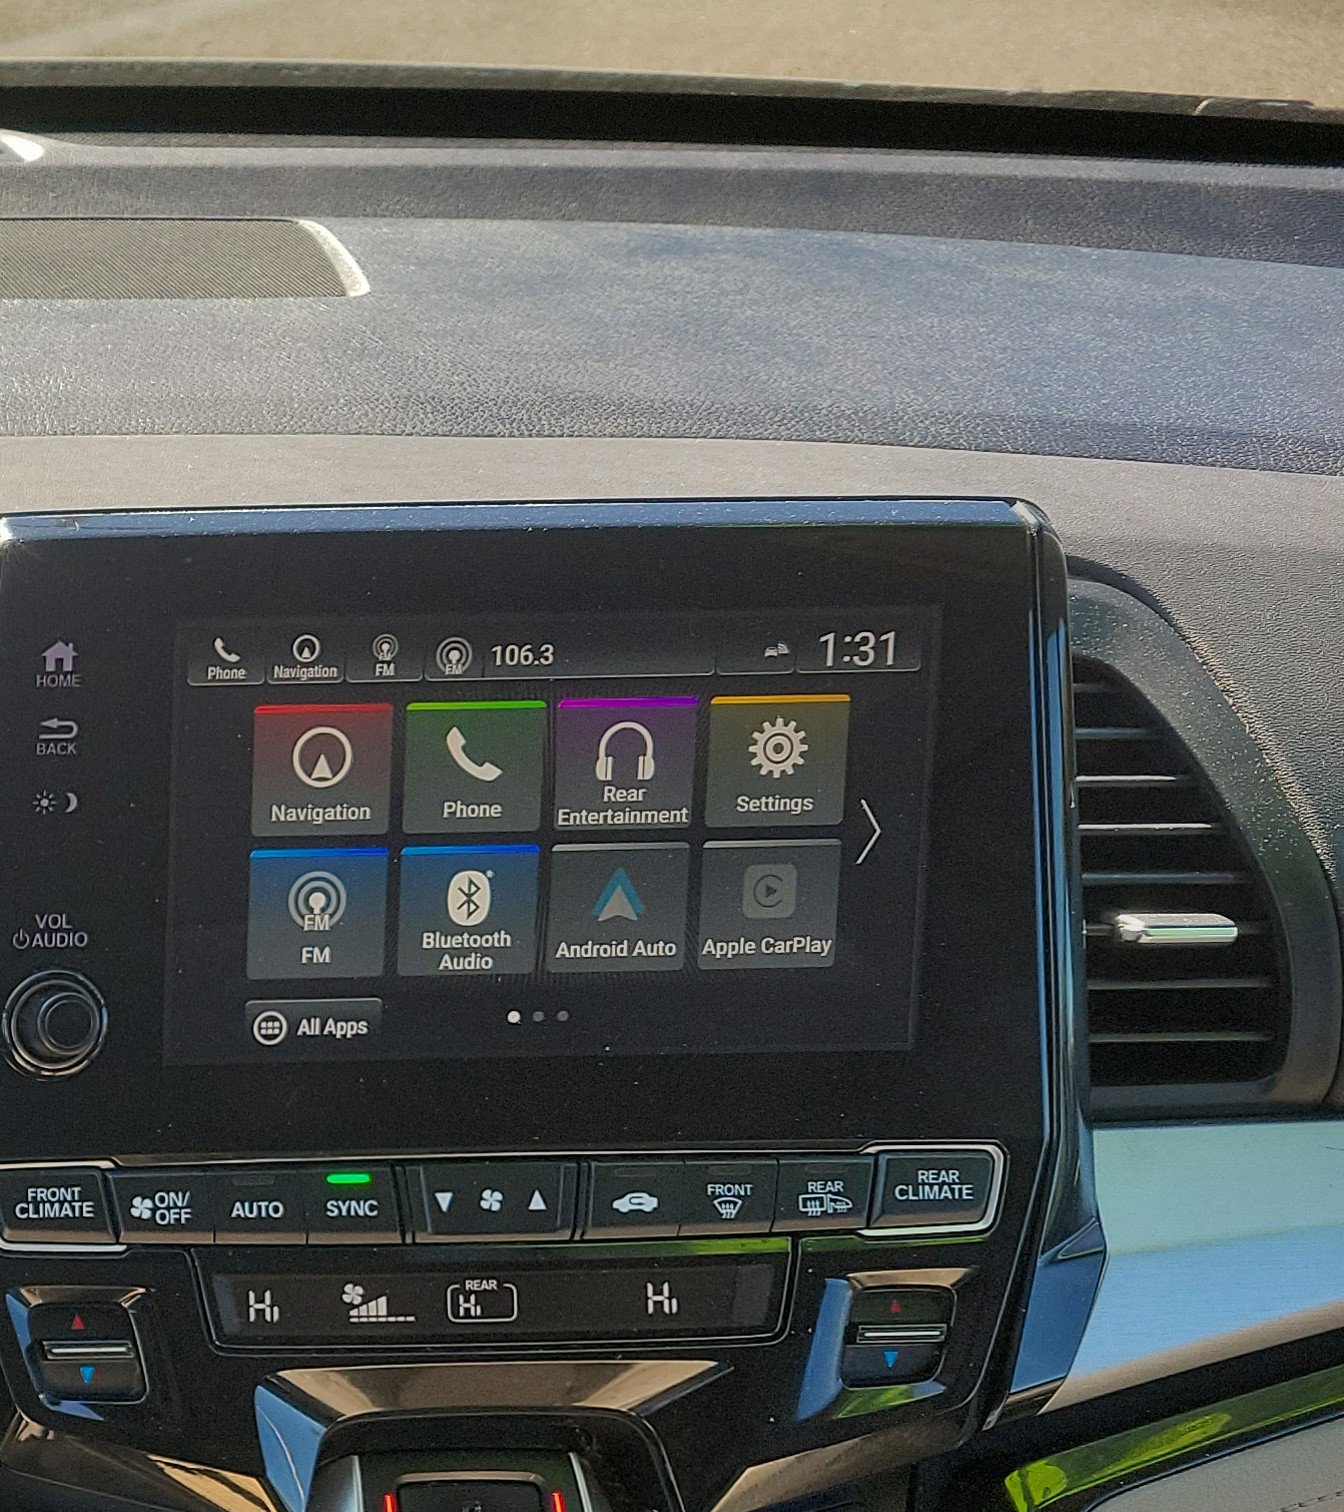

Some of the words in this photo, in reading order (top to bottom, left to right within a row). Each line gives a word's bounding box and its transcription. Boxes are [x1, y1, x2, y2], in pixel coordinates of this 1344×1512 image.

[490, 643, 554, 667] 106.3
[819, 631, 898, 667] 1:31
[207, 666, 247, 680] Phone
[273, 665, 338, 680] Navigation
[375, 663, 395, 676] FM
[36, 674, 81, 687] HOME
[36, 742, 77, 755] BACK
[604, 786, 647, 802] Rear
[271, 803, 372, 824] Navigation
[443, 801, 503, 819] Phone
[736, 795, 814, 815] Settings
[557, 806, 689, 826] Entertainment
[35, 914, 72, 929] VOL
[303, 915, 330, 931] FM
[32, 931, 88, 948] AUDIO
[421, 930, 512, 950] Bluetooth
[702, 937, 756, 958] Apple
[761, 936, 833, 957] CarPlay
[301, 947, 331, 964] FM
[555, 940, 628, 958] Android
[632, 940, 677, 957] Auto
[438, 952, 493, 971] Audio
[297, 1018, 319, 1036] All
[323, 1018, 369, 1039] Apps
[917, 1170, 960, 1183] REAR
[27, 1187, 81, 1202] FRONT
[707, 1184, 753, 1196] FRONT
[807, 1180, 844, 1193] REAR
[894, 1184, 974, 1200] CLIMATE
[154, 1190, 190, 1208] ON/
[15, 1202, 94, 1219] CLIMATE
[155, 1208, 192, 1225] OFF
[230, 1201, 284, 1219] AUTO
[325, 1200, 379, 1218] SYNC
[465, 1279, 497, 1291] REAR
